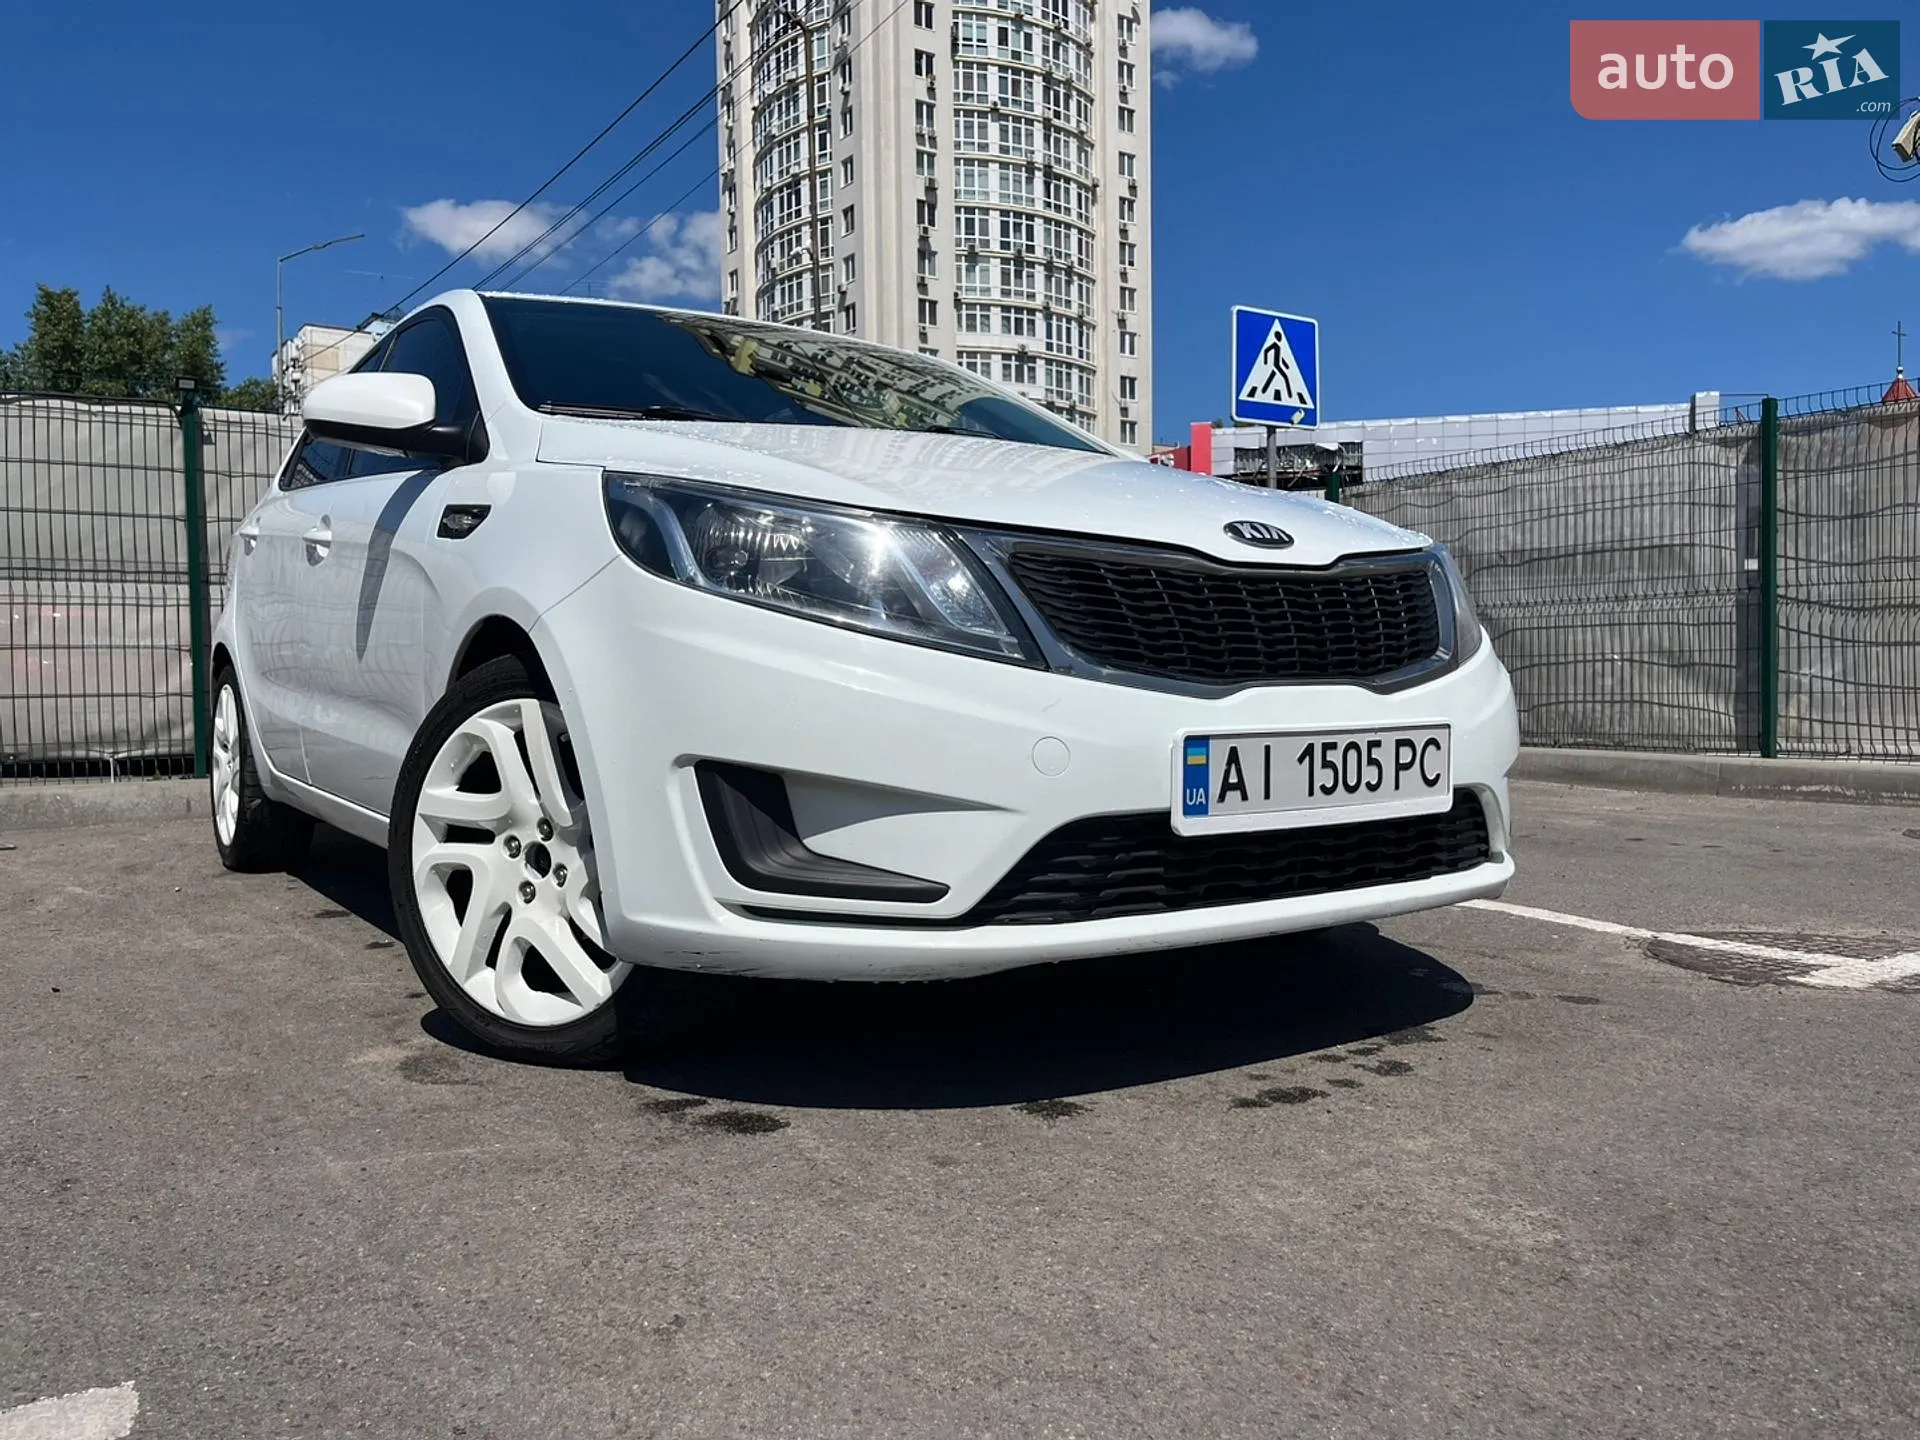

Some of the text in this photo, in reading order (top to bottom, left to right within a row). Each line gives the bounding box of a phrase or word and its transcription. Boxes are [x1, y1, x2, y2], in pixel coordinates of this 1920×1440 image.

[1232, 522, 1290, 542] KIA
[1296, 739, 1384, 798] 1505
[1393, 737, 1442, 792] PC
[1185, 787, 1207, 806] UA
